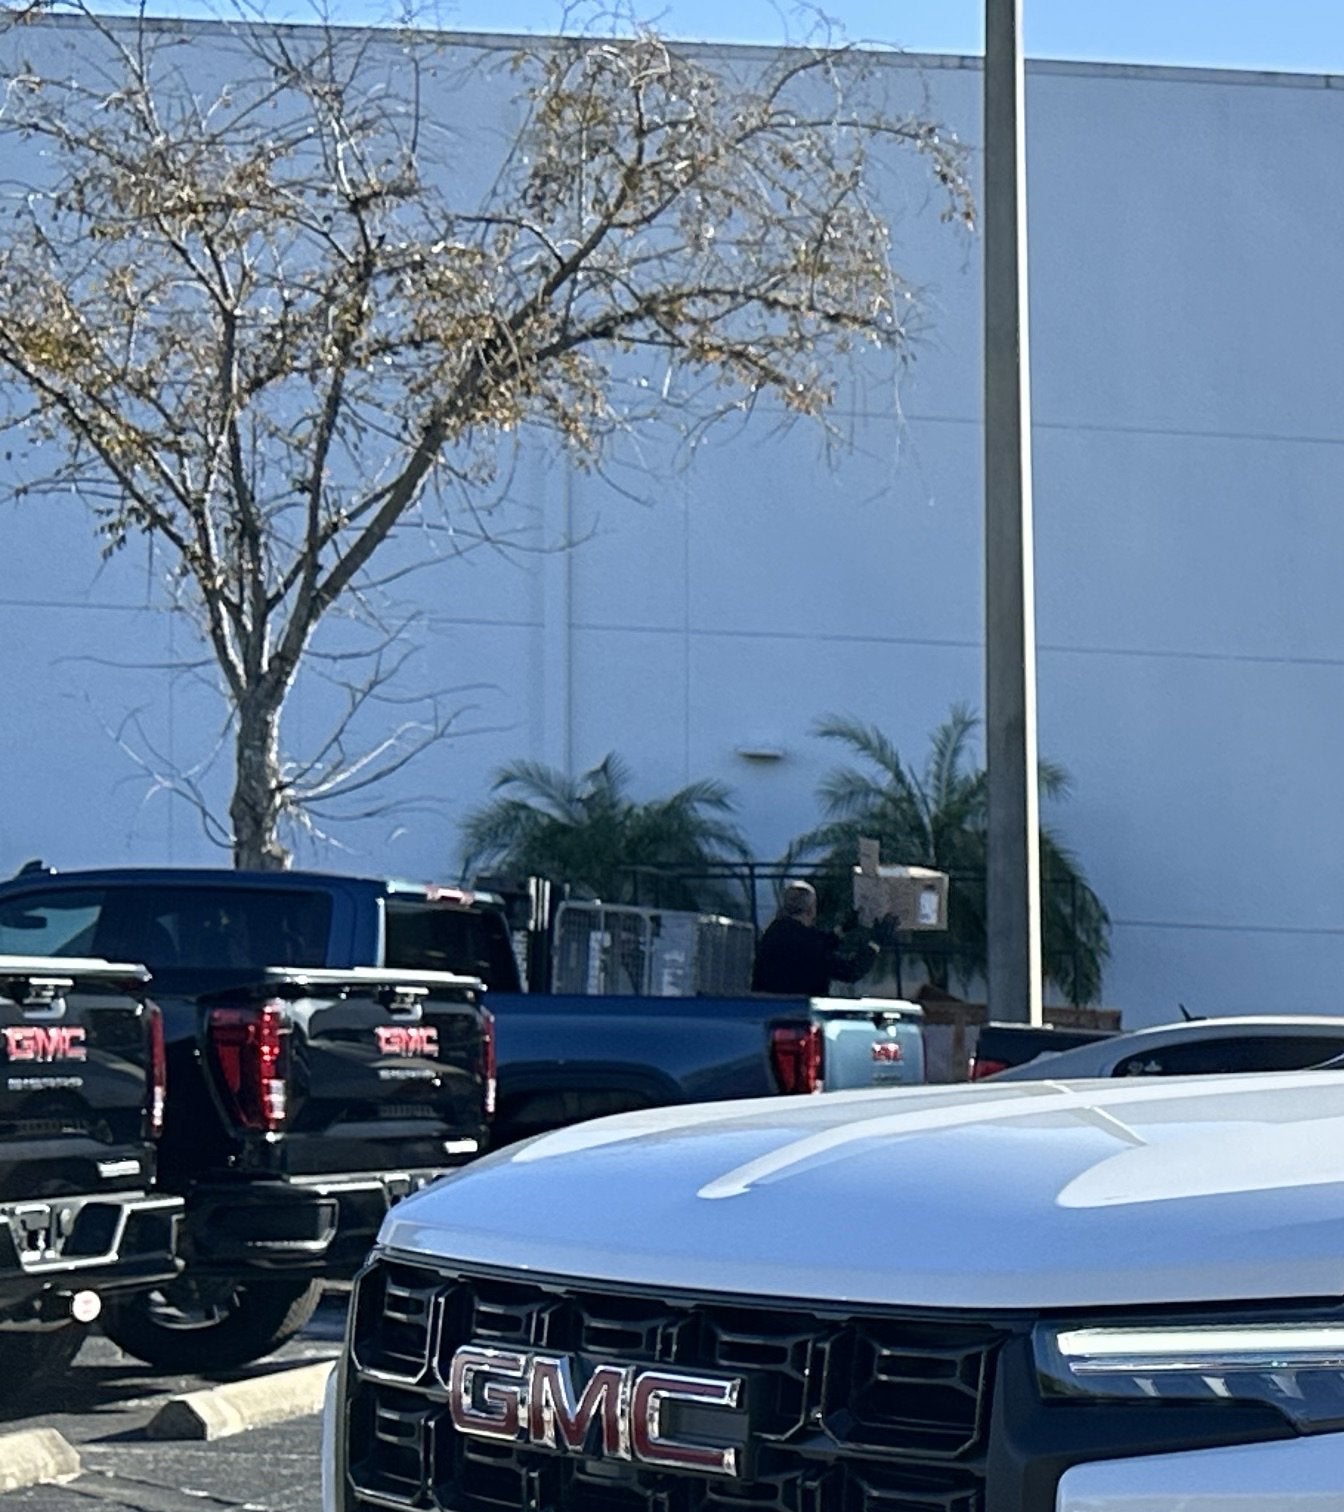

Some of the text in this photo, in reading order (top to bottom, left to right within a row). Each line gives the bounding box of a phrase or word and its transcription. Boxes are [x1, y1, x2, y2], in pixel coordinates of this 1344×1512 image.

[2, 1026, 87, 1062] GMC
[374, 1026, 439, 1057] GMC
[450, 1345, 742, 1477] GMC
